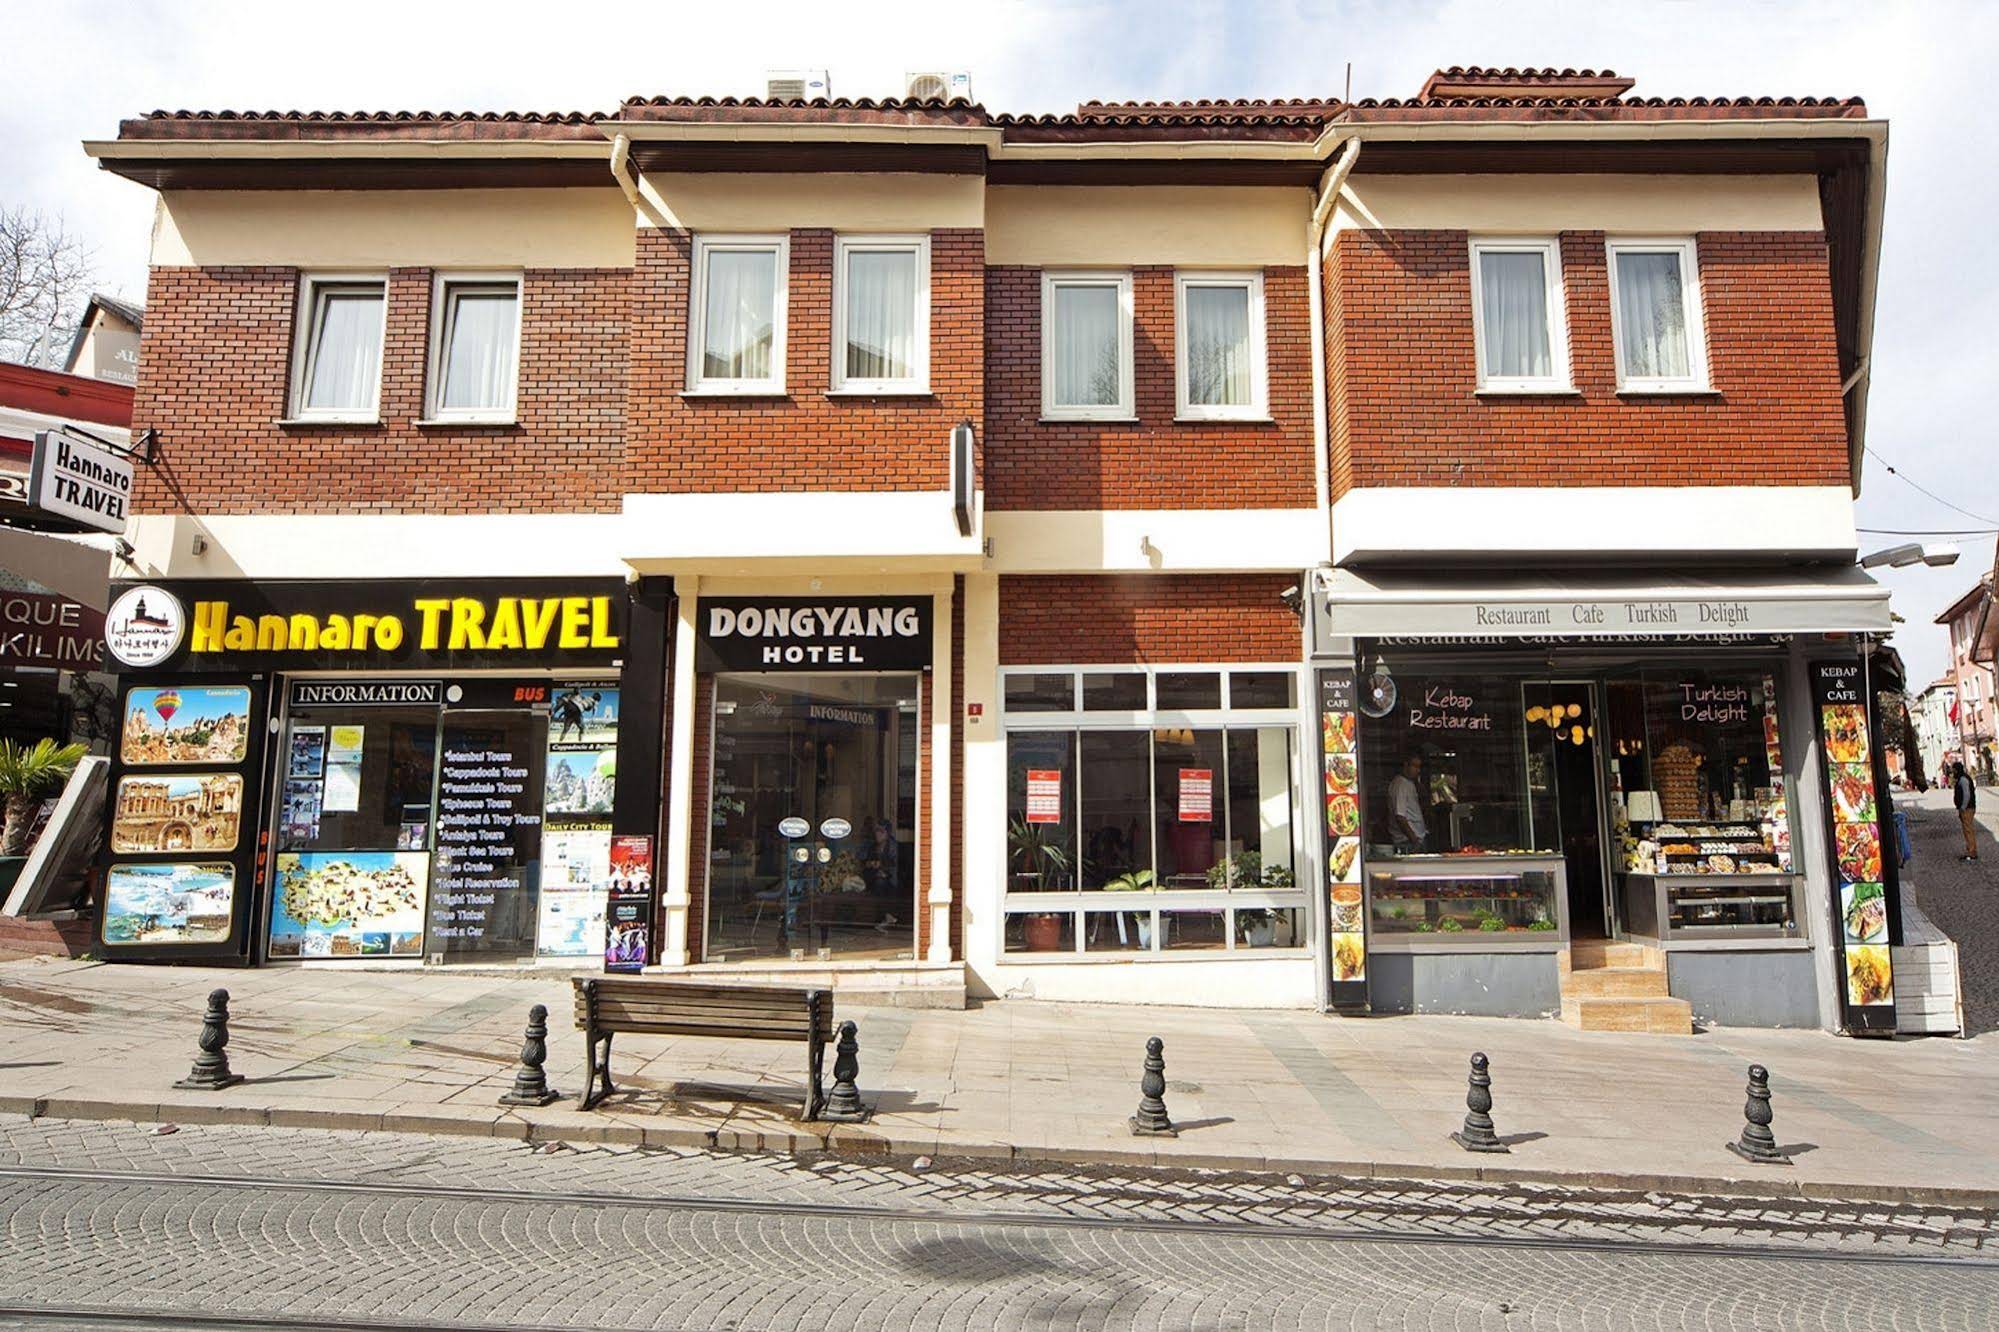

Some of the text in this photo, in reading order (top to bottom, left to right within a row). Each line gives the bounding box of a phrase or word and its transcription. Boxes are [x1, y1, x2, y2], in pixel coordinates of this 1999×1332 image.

[57, 443, 129, 491] Hannaro
[54, 475, 125, 521] TRAVEL
[0, 598, 81, 627] QUE
[1476, 602, 1751, 627] Restaurant Cafe Turkish Delight
[191, 597, 621, 652] Hannaro TRAVEL
[709, 607, 919, 638] DONGYANG
[763, 646, 864, 663] HOTEL
[1820, 667, 1858, 677] KEBAP
[1323, 680, 1351, 689] KEBAP
[1836, 679, 1845, 689] &
[299, 685, 435, 702] INFORMATION
[513, 687, 544, 701] BUS
[1425, 686, 1473, 711] Kebap
[1680, 684, 1747, 701] Turkish
[1827, 690, 1857, 701] CAFE
[1326, 699, 1350, 708] CAFE
[810, 705, 875, 725] INFORMATION
[1410, 709, 1491, 730] Restaurant
[1681, 704, 1748, 723] Delight
[486, 751, 512, 761] Tours
[501, 767, 528, 777] Tours
[497, 782, 523, 793] Tours
[485, 798, 512, 809] Tours
[482, 814, 490, 824] &
[492, 814, 513, 826] Troy
[514, 813, 541, 824] Tours
[478, 829, 505, 840] Tours
[468, 845, 487, 857] Sea
[487, 845, 514, 857] Tours
[256, 831, 268, 885] BUS
[463, 862, 494, 872] Cruise
[466, 893, 495, 904] Ticket
[457, 910, 485, 920] Ticket
[467, 926, 485, 936] Car
